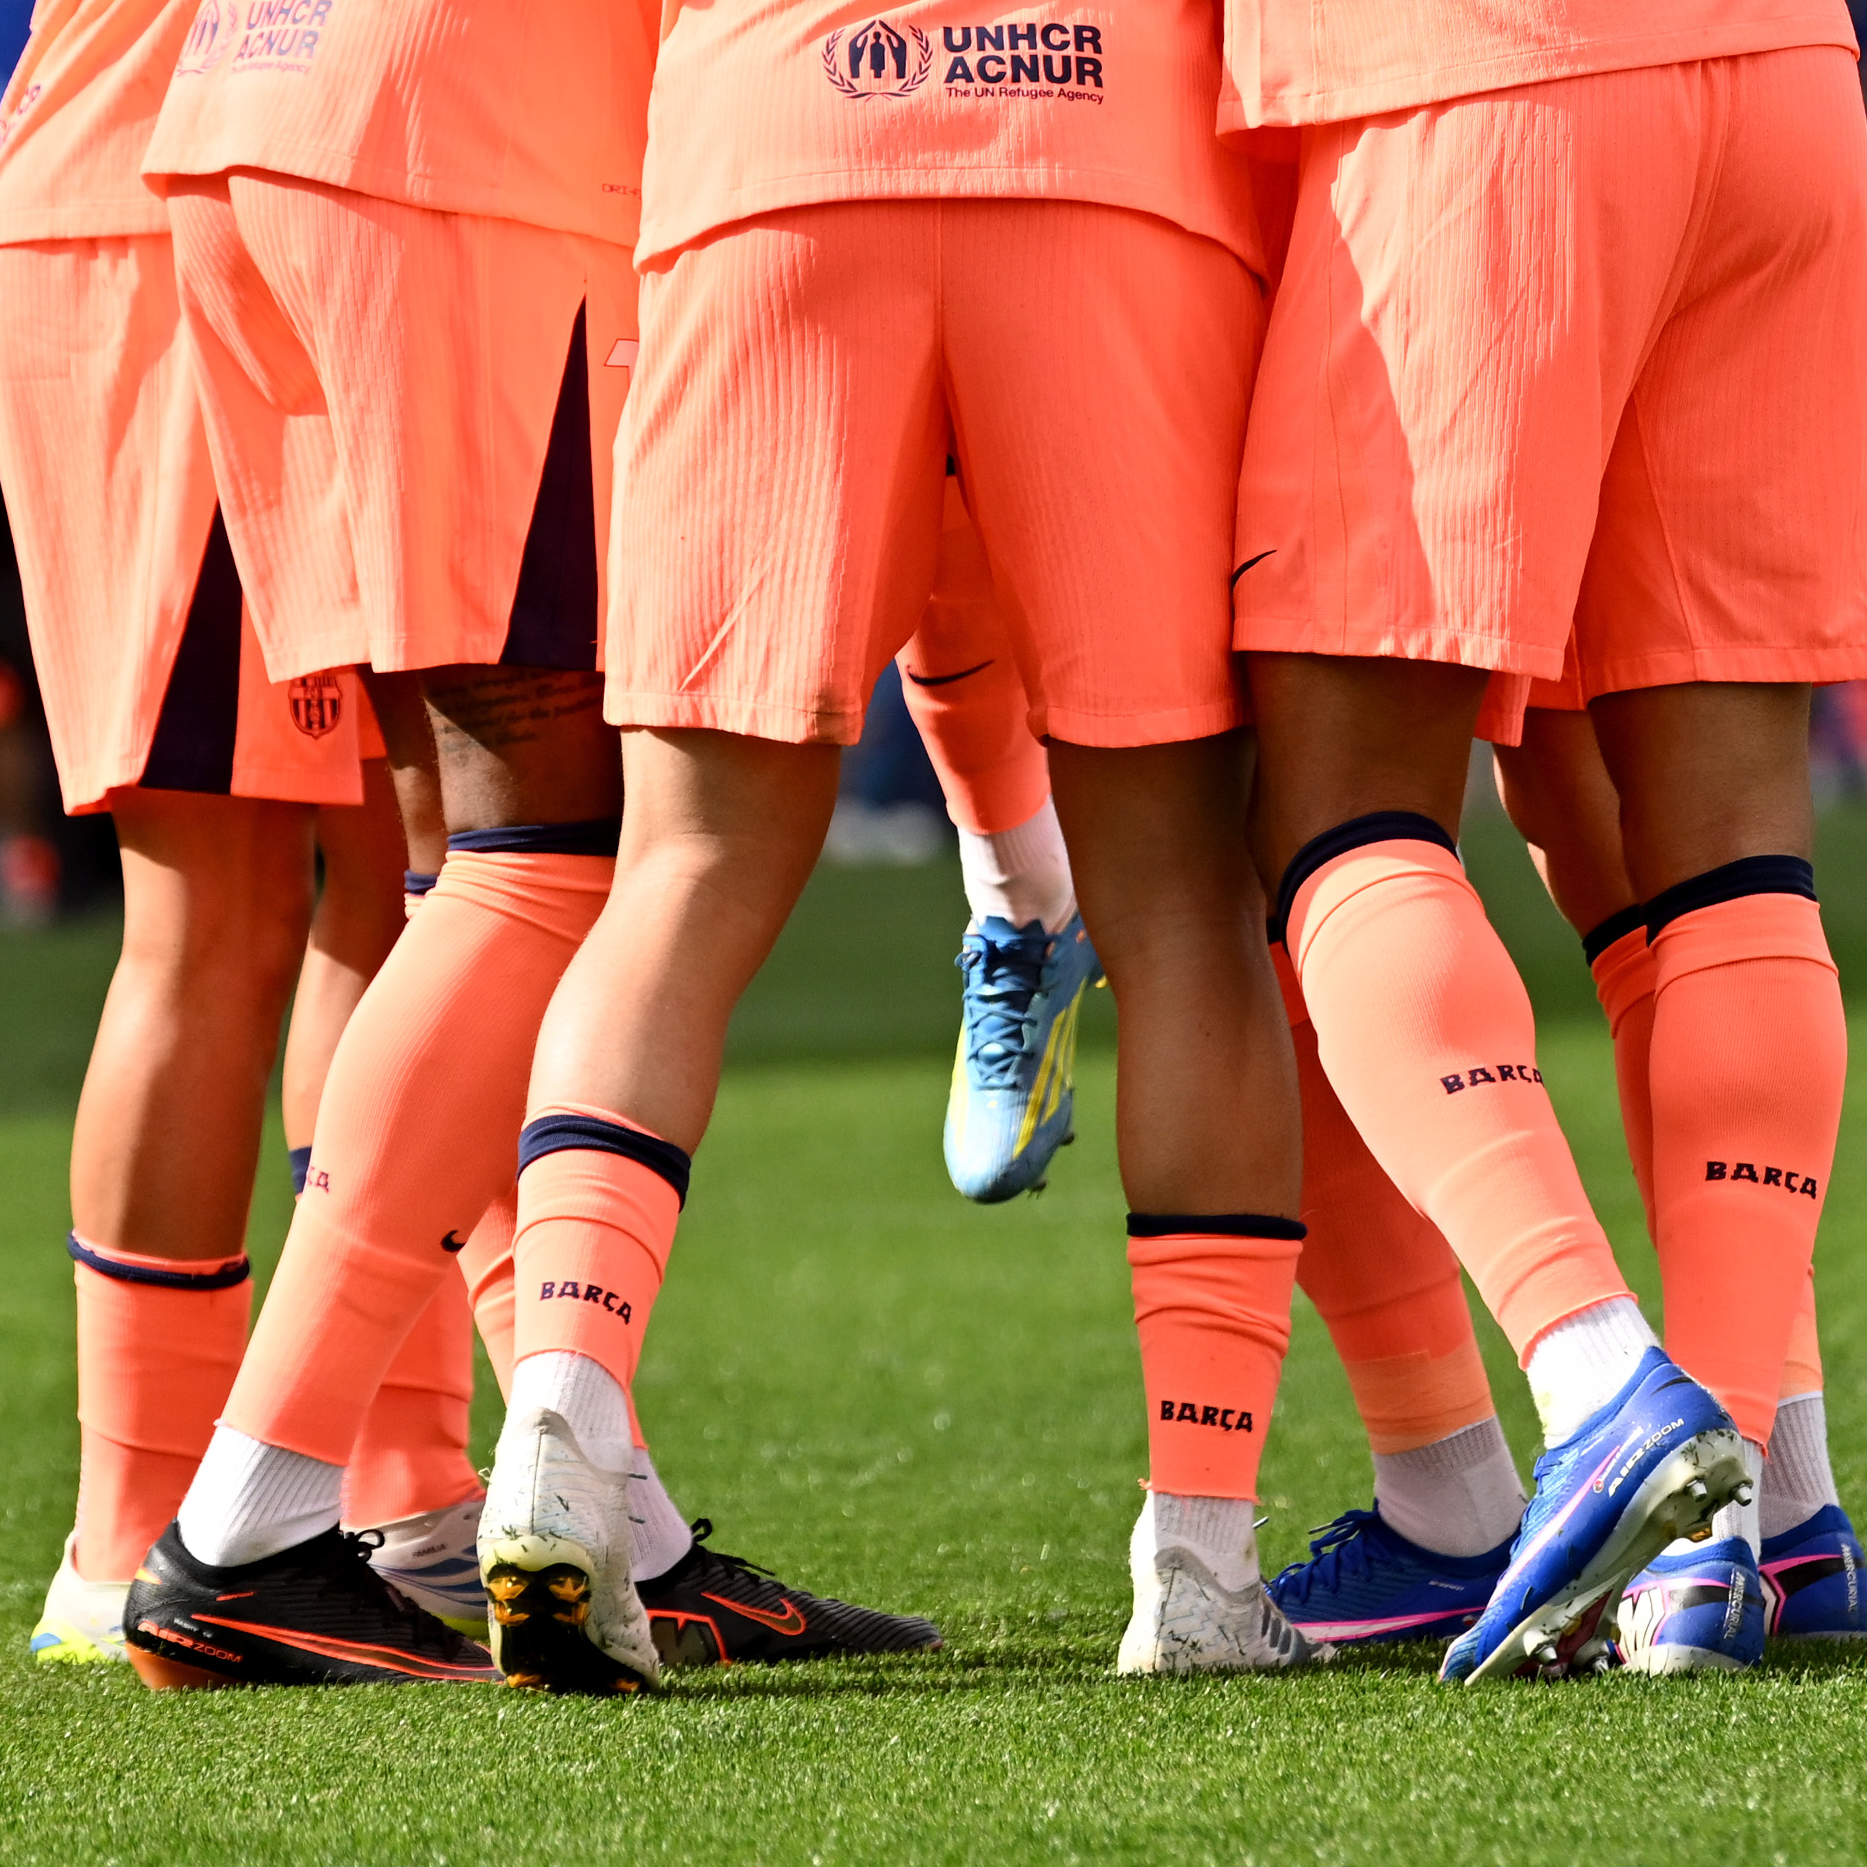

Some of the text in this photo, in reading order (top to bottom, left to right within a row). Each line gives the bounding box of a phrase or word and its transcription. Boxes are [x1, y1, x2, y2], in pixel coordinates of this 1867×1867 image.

[233, 29, 320, 62] ACNUR
[942, 23, 1103, 55] UNHCR
[943, 54, 1103, 89] ACNUR
[946, 86, 1104, 105] The UN Refugee Agency
[1705, 1161, 1818, 1199] BARÇA
[539, 1280, 632, 1326] BARÇA
[1159, 1400, 1254, 1434] BARÇA
[1608, 1448, 1645, 1497] AIR
[1643, 1418, 1685, 1449] ZOOM
[192, 1643, 243, 1664] ZOOM
